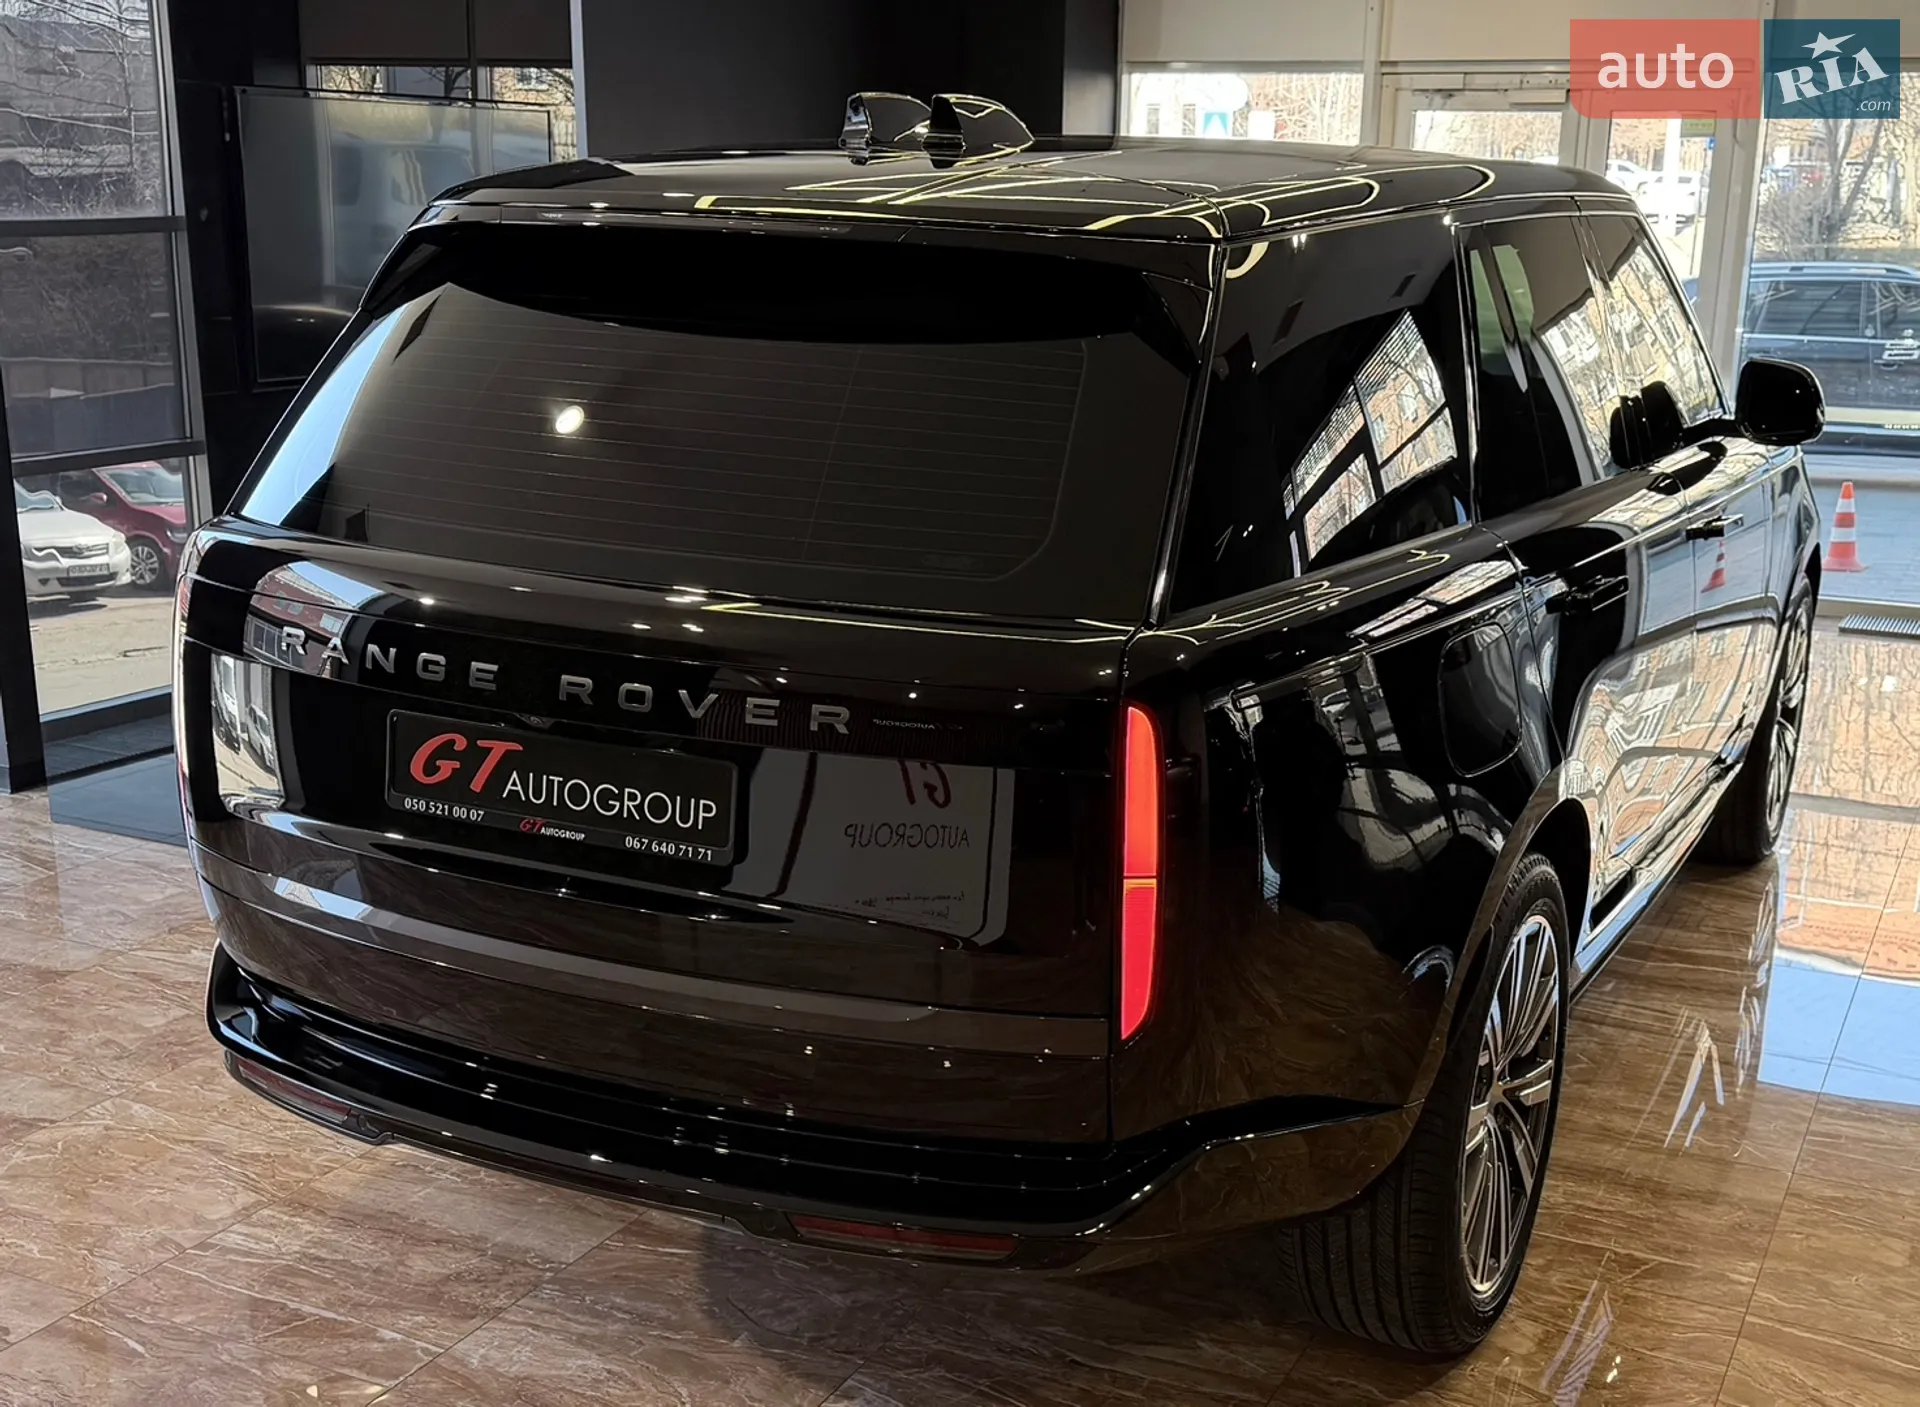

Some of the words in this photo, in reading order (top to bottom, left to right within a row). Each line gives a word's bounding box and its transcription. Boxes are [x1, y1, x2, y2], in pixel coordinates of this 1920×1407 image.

[281, 625, 499, 690] RANGE
[559, 674, 850, 734] ROVER
[410, 733, 524, 793] GT
[502, 770, 717, 830] AUTOGROUP
[404, 797, 426, 811] 050
[428, 801, 449, 816] 521
[452, 806, 467, 819] 00
[469, 809, 485, 822] 07
[519, 818, 547, 833] GT
[540, 826, 586, 841] AUTOGROUP
[625, 836, 649, 850] 067
[651, 840, 676, 855] 640
[679, 844, 693, 858] 71
[697, 848, 712, 862] 71
